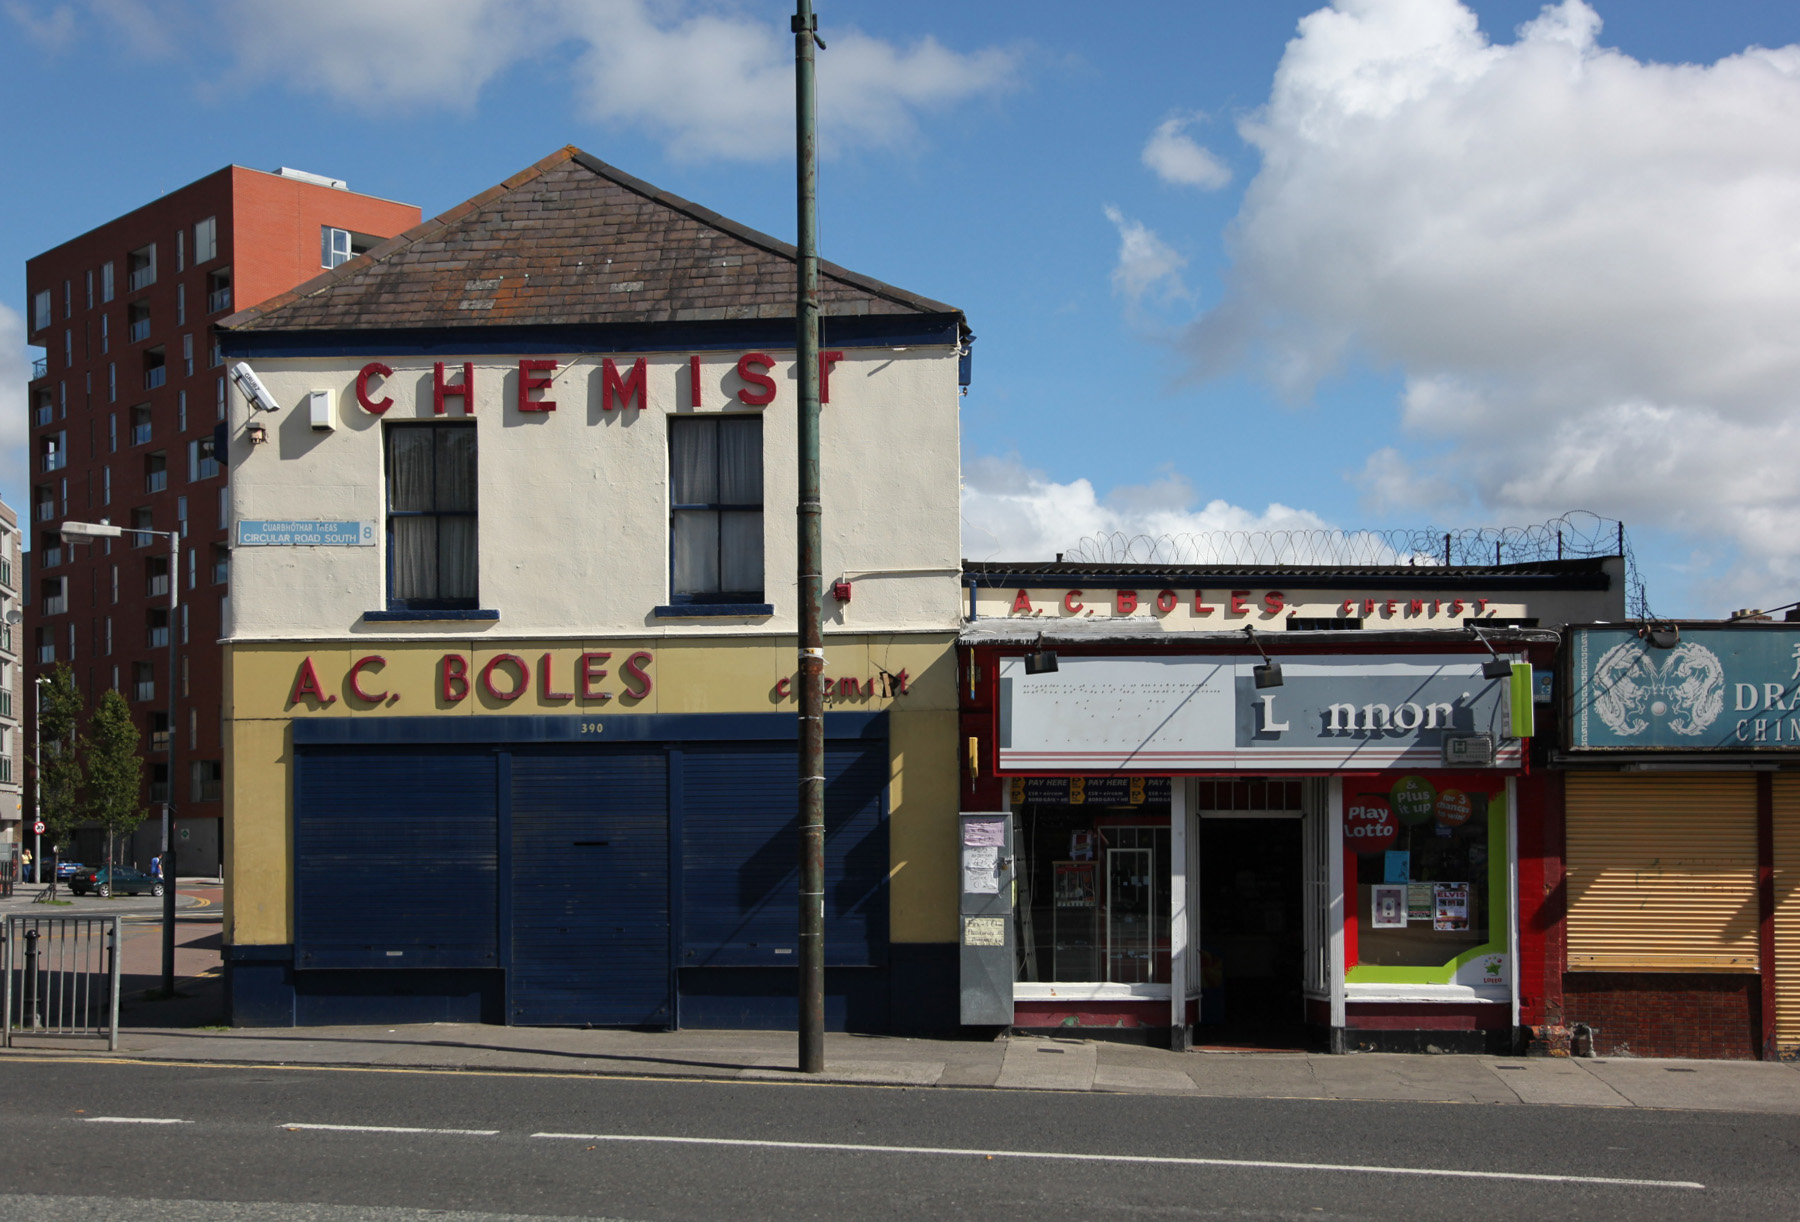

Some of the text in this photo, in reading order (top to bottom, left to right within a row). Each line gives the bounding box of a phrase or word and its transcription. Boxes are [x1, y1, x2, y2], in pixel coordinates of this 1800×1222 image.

[356, 351, 844, 414] CHEMIST
[243, 533, 357, 543] CIRCULAR ROAD SOUTH
[363, 526, 372, 539] 8
[443, 651, 654, 702] BOLES
[581, 723, 604, 733] 390
[1397, 790, 1430, 803] Plus
[1458, 794, 1466, 804] 3
[1348, 806, 1389, 823] Play
[1398, 802, 1431, 814] it up
[1343, 823, 1393, 837] Lotto
